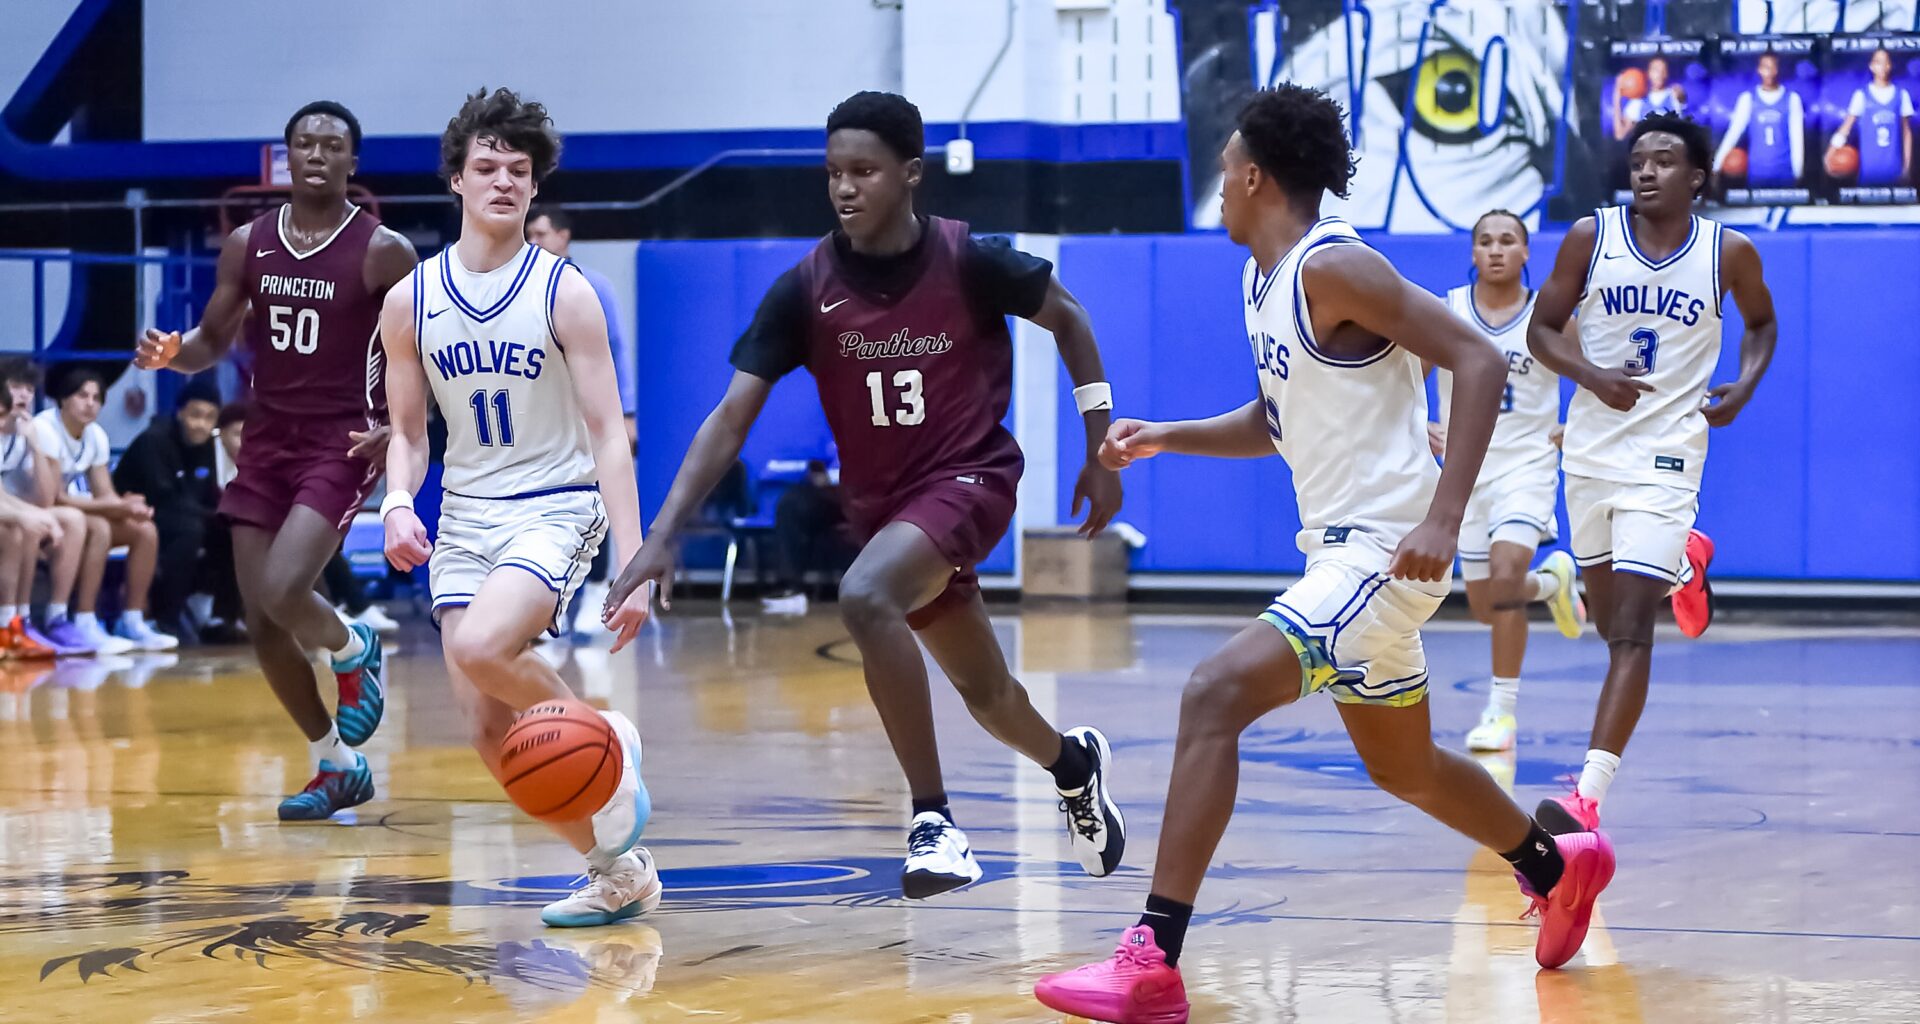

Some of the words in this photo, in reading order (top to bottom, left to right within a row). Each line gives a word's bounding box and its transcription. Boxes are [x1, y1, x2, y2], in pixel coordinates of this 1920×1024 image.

[260, 274, 335, 300] PRINCETON
[1599, 285, 1705, 327] WOLVES
[269, 305, 320, 354] 50
[838, 327, 953, 359] Panthers
[1625, 327, 1660, 377] 3
[429, 340, 546, 381] WOLVES
[469, 389, 514, 447] 11
[866, 369, 925, 426] 13
